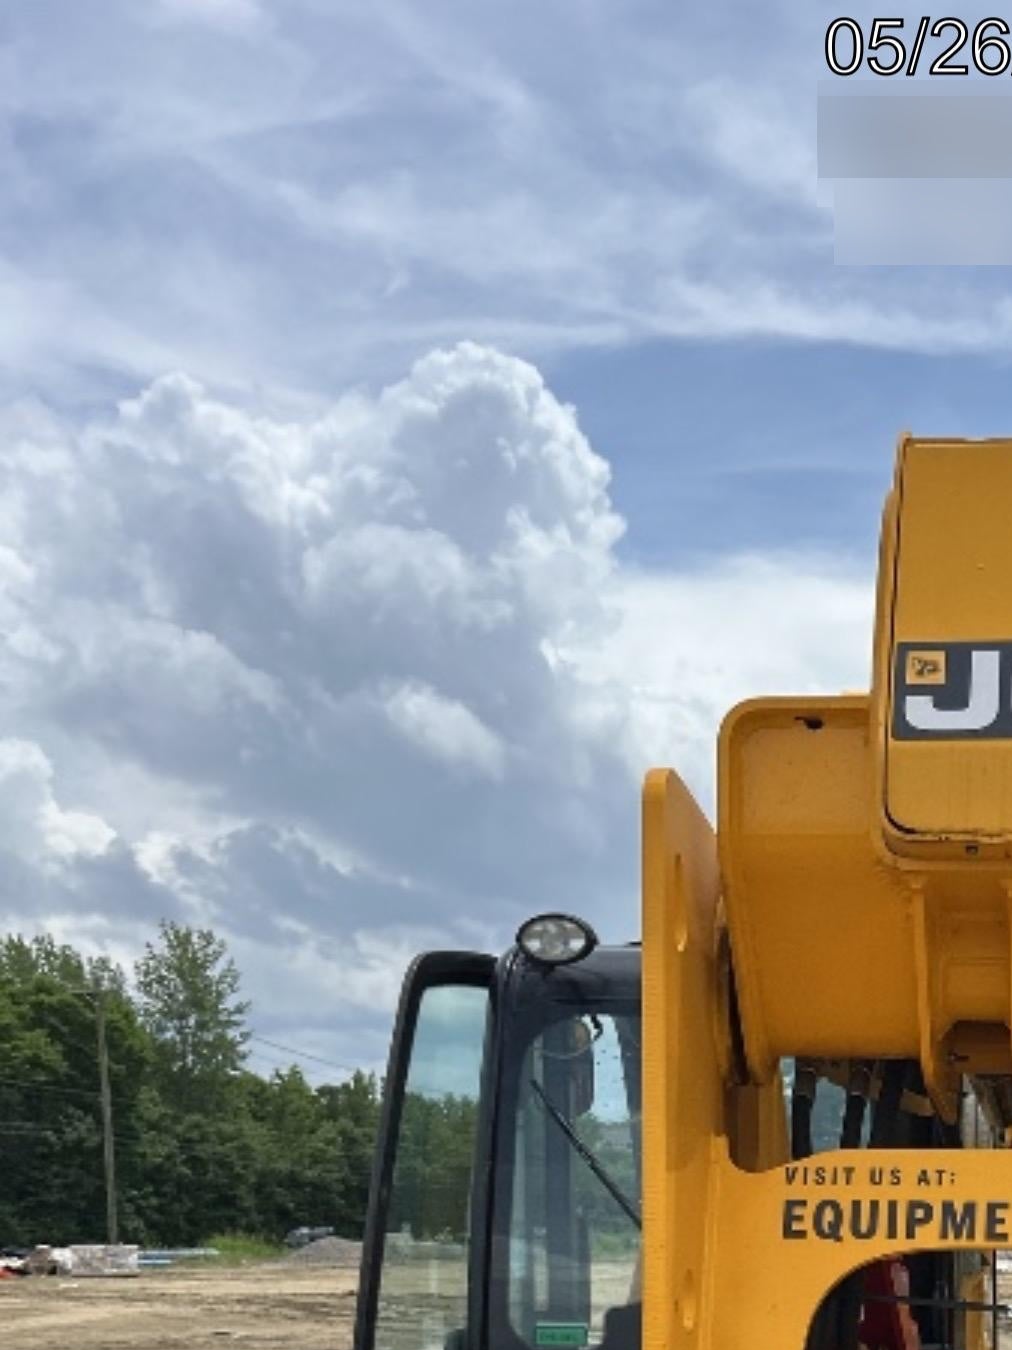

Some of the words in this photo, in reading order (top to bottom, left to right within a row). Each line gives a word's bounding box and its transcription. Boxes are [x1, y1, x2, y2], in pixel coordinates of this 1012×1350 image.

[784, 1166, 855, 1186] VISIT
[869, 1168, 901, 1186] US
[916, 1169, 957, 1187] AT:
